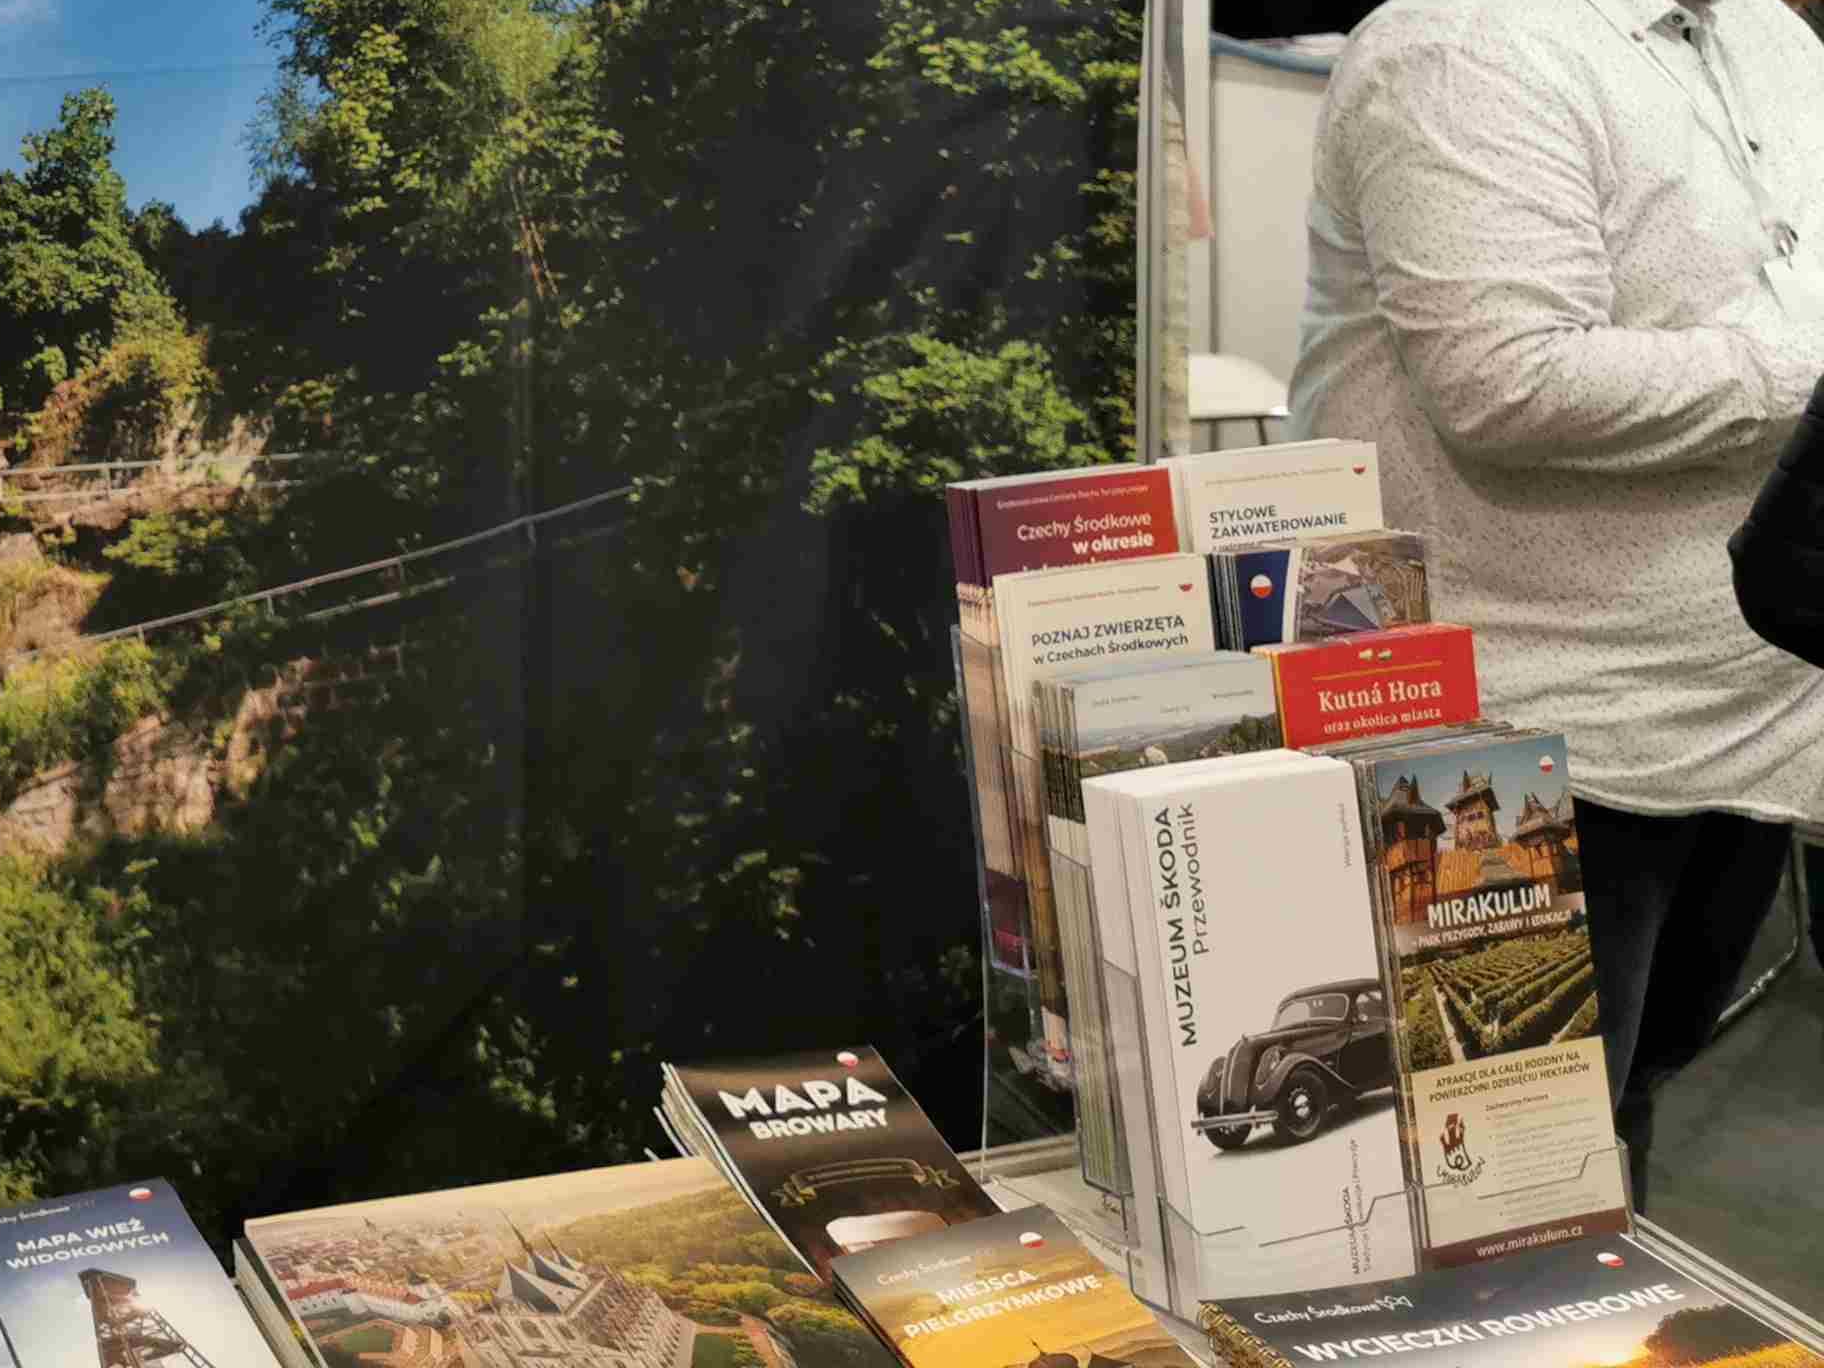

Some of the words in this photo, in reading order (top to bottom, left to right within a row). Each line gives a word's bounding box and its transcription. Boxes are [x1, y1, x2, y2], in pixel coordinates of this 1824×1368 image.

[1016, 519, 1072, 541] Czechy
[1073, 511, 1152, 533] Środkowe
[1208, 504, 1278, 524] STYLOWE
[1211, 512, 1349, 539] ZAKWATEROWANIE
[1072, 540, 1089, 554] w
[1091, 530, 1155, 553] okresie
[1031, 628, 1090, 647] POZNAJ
[1094, 615, 1186, 636] ZWIERZĘTA
[1033, 655, 1044, 664] w
[1046, 645, 1106, 664] Czechach
[1107, 633, 1189, 654] Środkowych
[1317, 682, 1384, 713] Kutná
[1387, 680, 1443, 704] Hora
[1352, 712, 1399, 730] okolica
[1400, 707, 1443, 722] miasta
[1154, 806, 1182, 909] ŠKODA
[1176, 802, 1210, 955] Przewodnik
[1427, 883, 1552, 929] MIRAKULUM
[1167, 917, 1197, 1047] MUZEUM
[1478, 1067, 1498, 1080] DLA
[1566, 1050, 1581, 1062] NA
[717, 1076, 888, 1121] MAPA
[749, 1105, 890, 1141] BROWARY
[5, 1232, 170, 1270] WIDOKOWYCH
[16, 1231, 83, 1254] MAPA
[85, 1216, 145, 1240] WIEŻ
[1476, 1226, 1584, 1258] www.mirakulum.cz
[935, 1268, 1039, 1306] MIEJSCA
[902, 1273, 1105, 1339] PIELGRZYMKOWE
[1293, 1323, 1482, 1362] WYCIECZKI
[1480, 1281, 1685, 1338] ROWEROWE
